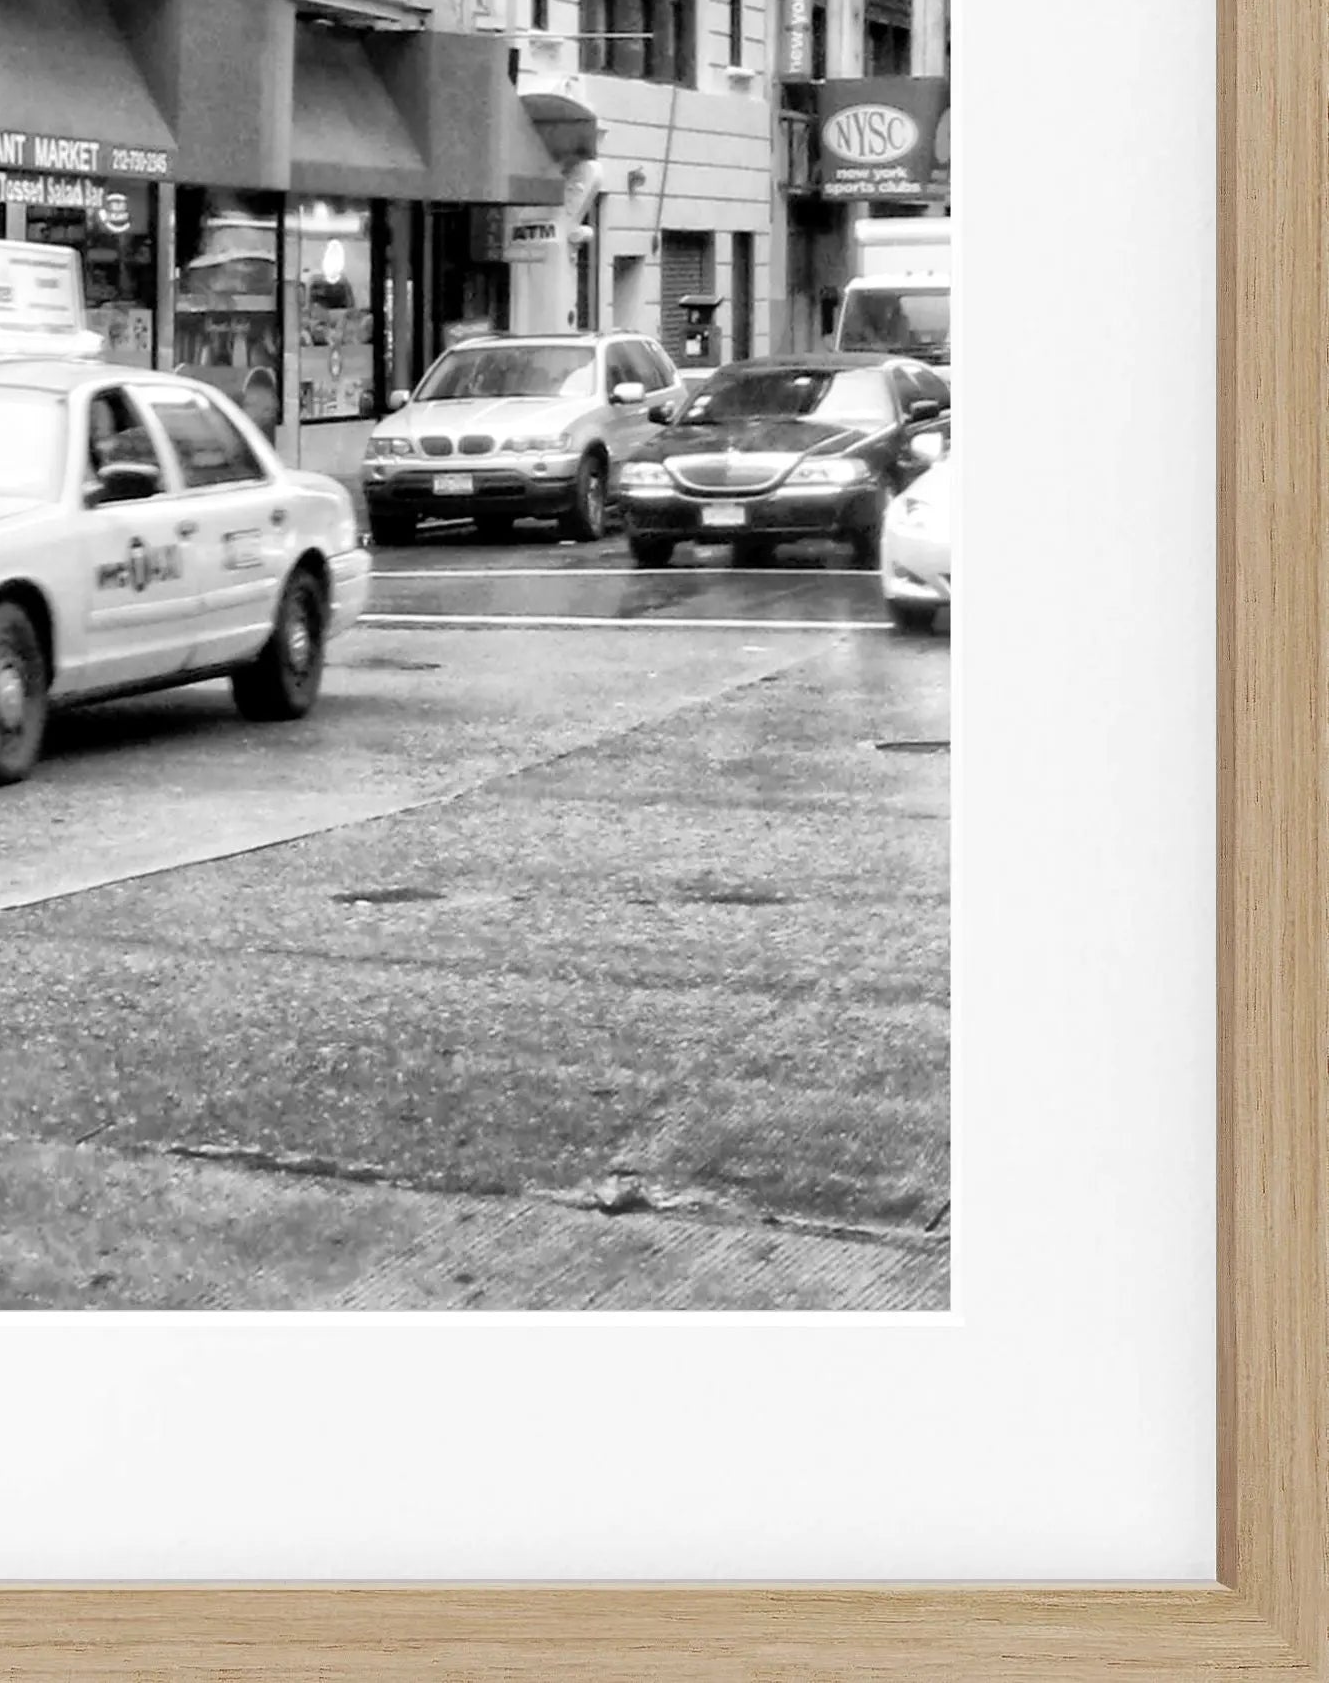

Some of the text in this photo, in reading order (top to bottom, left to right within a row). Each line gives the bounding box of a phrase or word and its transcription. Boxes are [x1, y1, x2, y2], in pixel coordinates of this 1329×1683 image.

[788, 31, 804, 74] new
[836, 111, 906, 157] NYSC
[34, 135, 100, 172] MARKET
[835, 166, 908, 182] new york
[823, 181, 876, 196] sports
[877, 180, 922, 194] clubs
[511, 223, 556, 241] ATM
